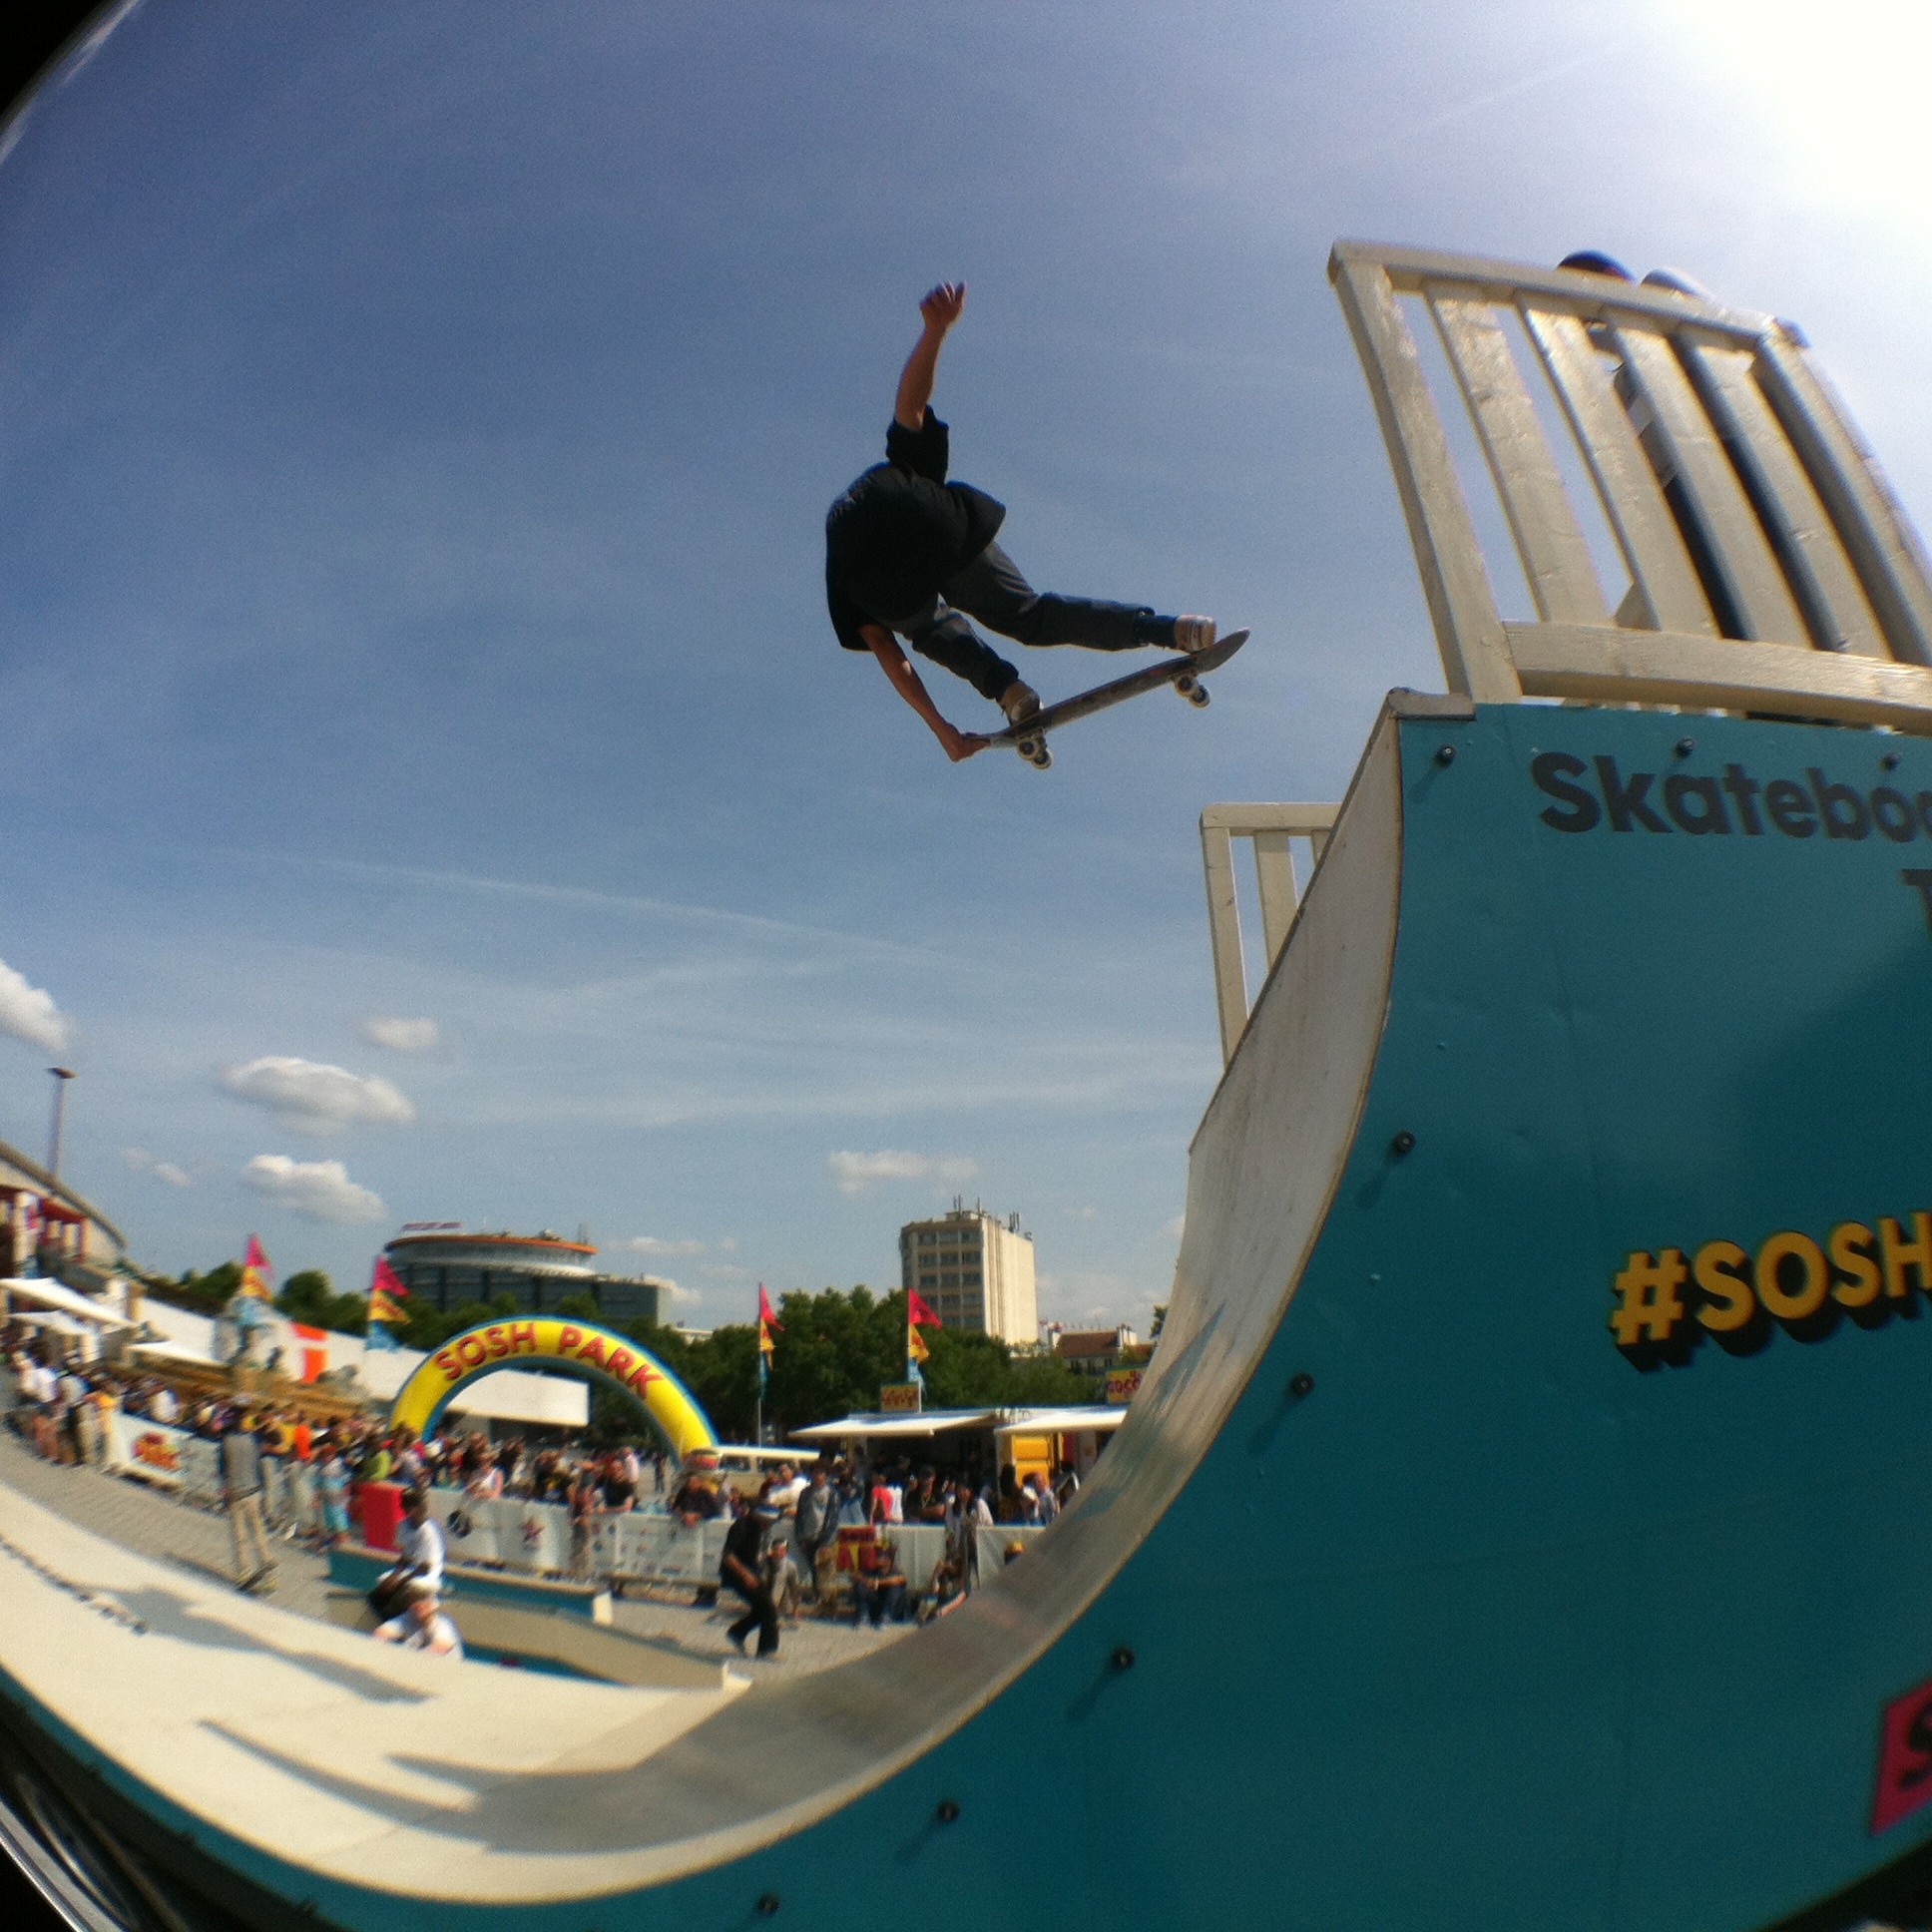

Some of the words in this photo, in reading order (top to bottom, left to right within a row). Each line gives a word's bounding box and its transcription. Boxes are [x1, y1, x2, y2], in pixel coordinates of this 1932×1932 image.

[1609, 1209, 1932, 1349] #SOSH
[435, 1322, 536, 1381] SOSH
[558, 1325, 665, 1399] PARK
